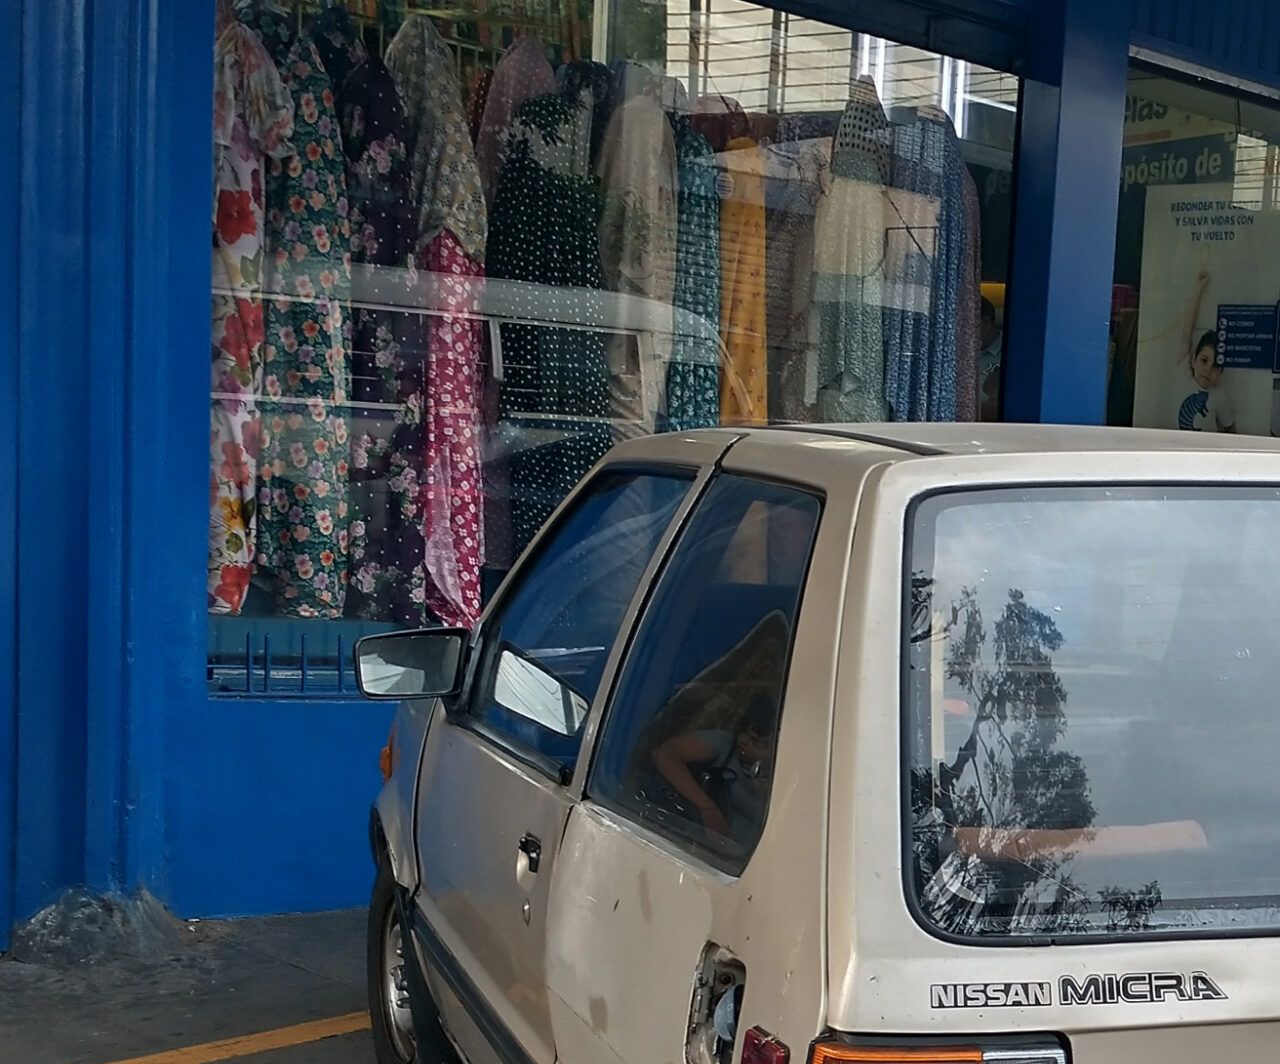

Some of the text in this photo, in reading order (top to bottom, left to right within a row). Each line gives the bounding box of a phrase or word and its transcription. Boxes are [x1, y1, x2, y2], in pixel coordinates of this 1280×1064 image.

[1120, 146, 1222, 192] pósito de
[1237, 215, 1254, 225] CON
[1204, 231, 1236, 241] VUELTO
[931, 970, 1228, 1008] NISSAN MICRA
